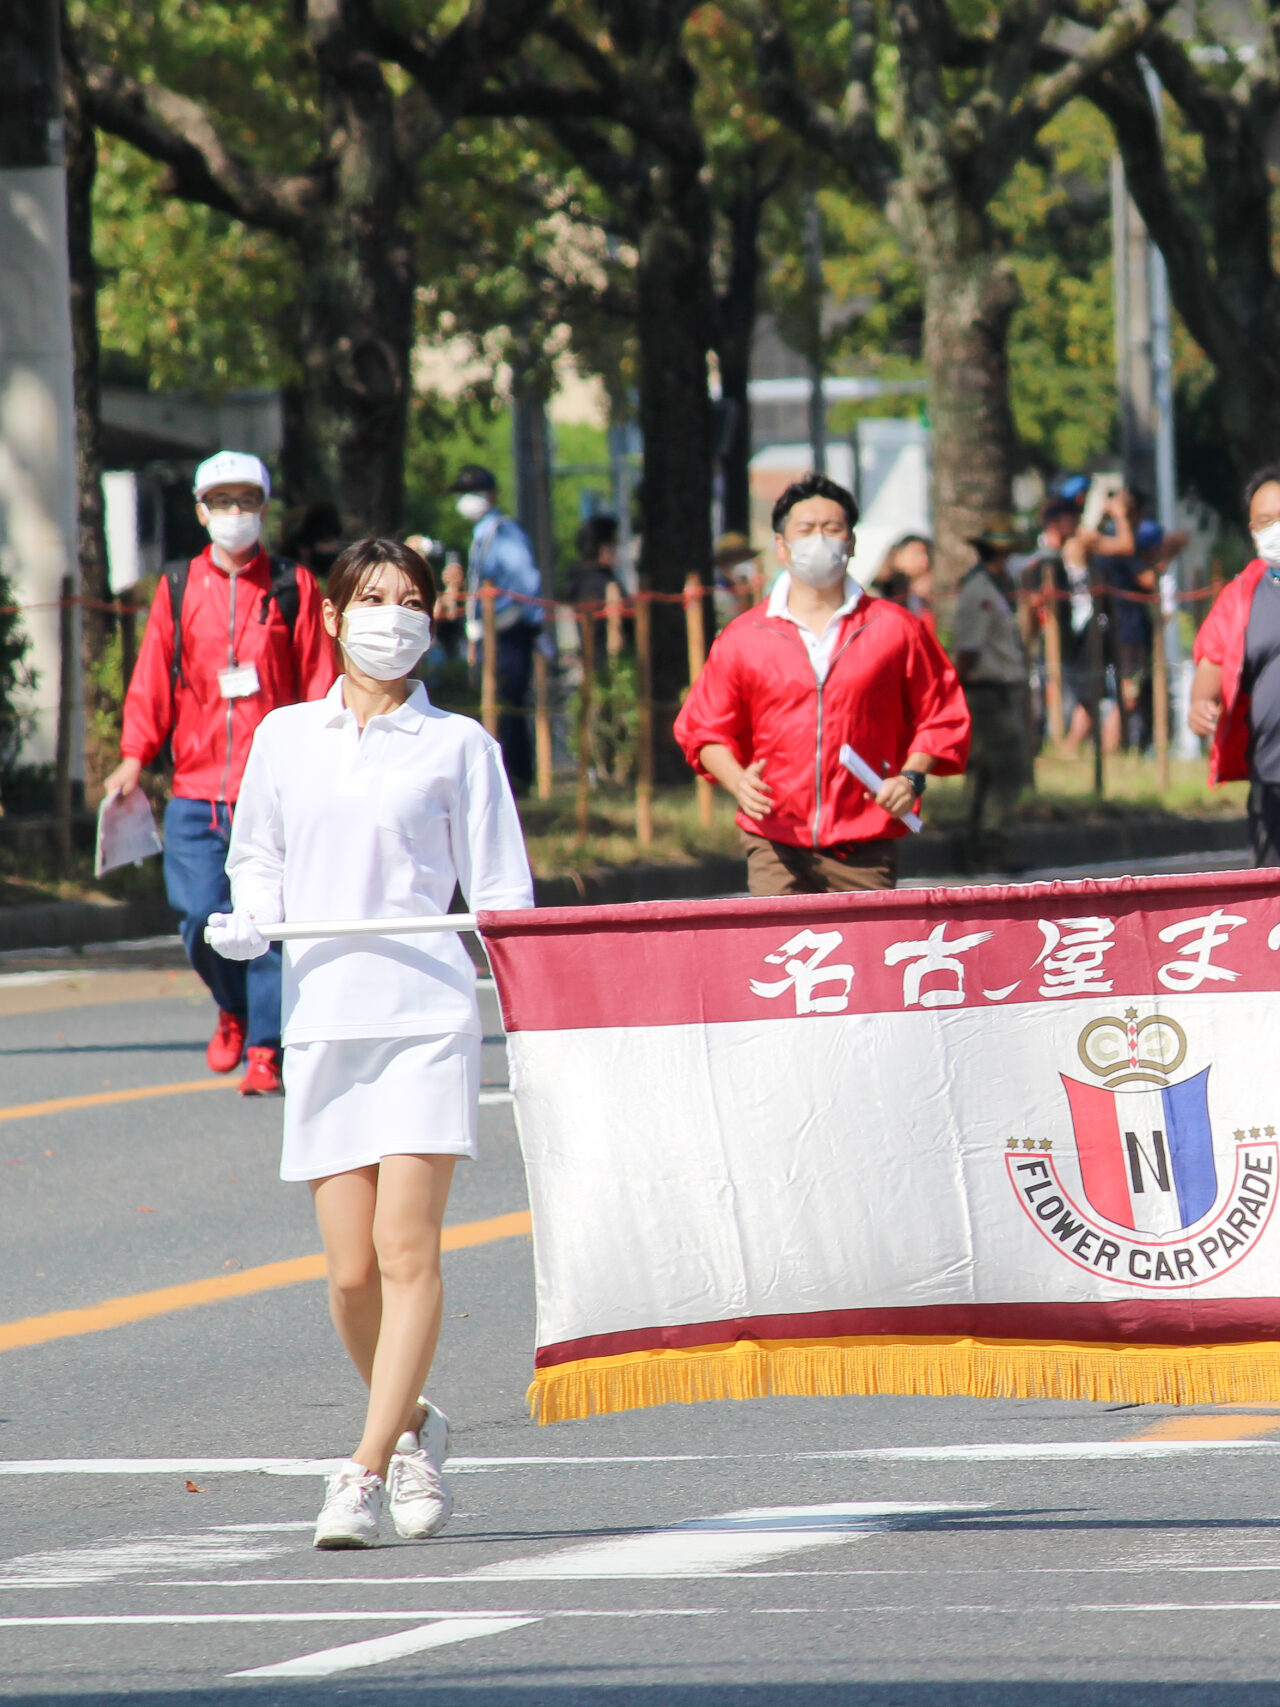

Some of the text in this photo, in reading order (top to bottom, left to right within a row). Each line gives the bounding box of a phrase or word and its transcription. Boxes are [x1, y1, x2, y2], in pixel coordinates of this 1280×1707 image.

[1125, 1130, 1171, 1194] N
[1016, 1152, 1273, 1281] FLOWER CAR PARADE
